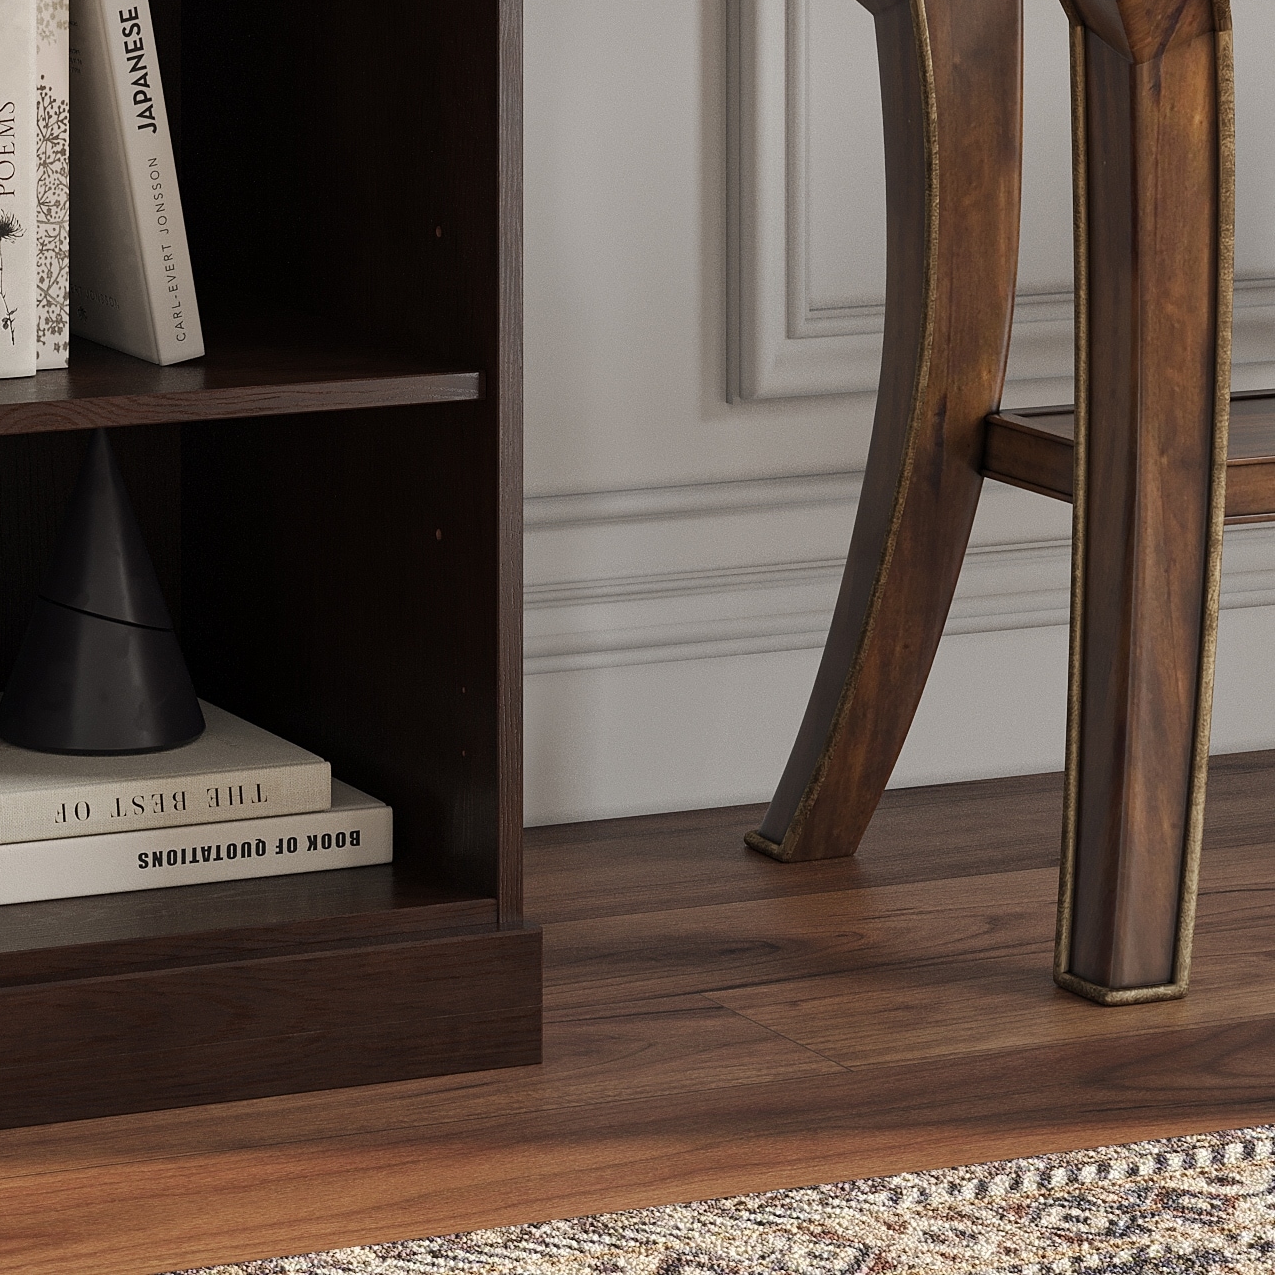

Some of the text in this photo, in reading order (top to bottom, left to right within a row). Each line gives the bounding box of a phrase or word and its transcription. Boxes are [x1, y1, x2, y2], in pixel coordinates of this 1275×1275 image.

[119, 6, 157, 134] JAPANESE
[148, 157, 187, 342] CARL-EVERT JONSSON
[54, 783, 268, 824] THE BEST OF
[137, 830, 361, 870] BOOK OF QUOTATIONS
